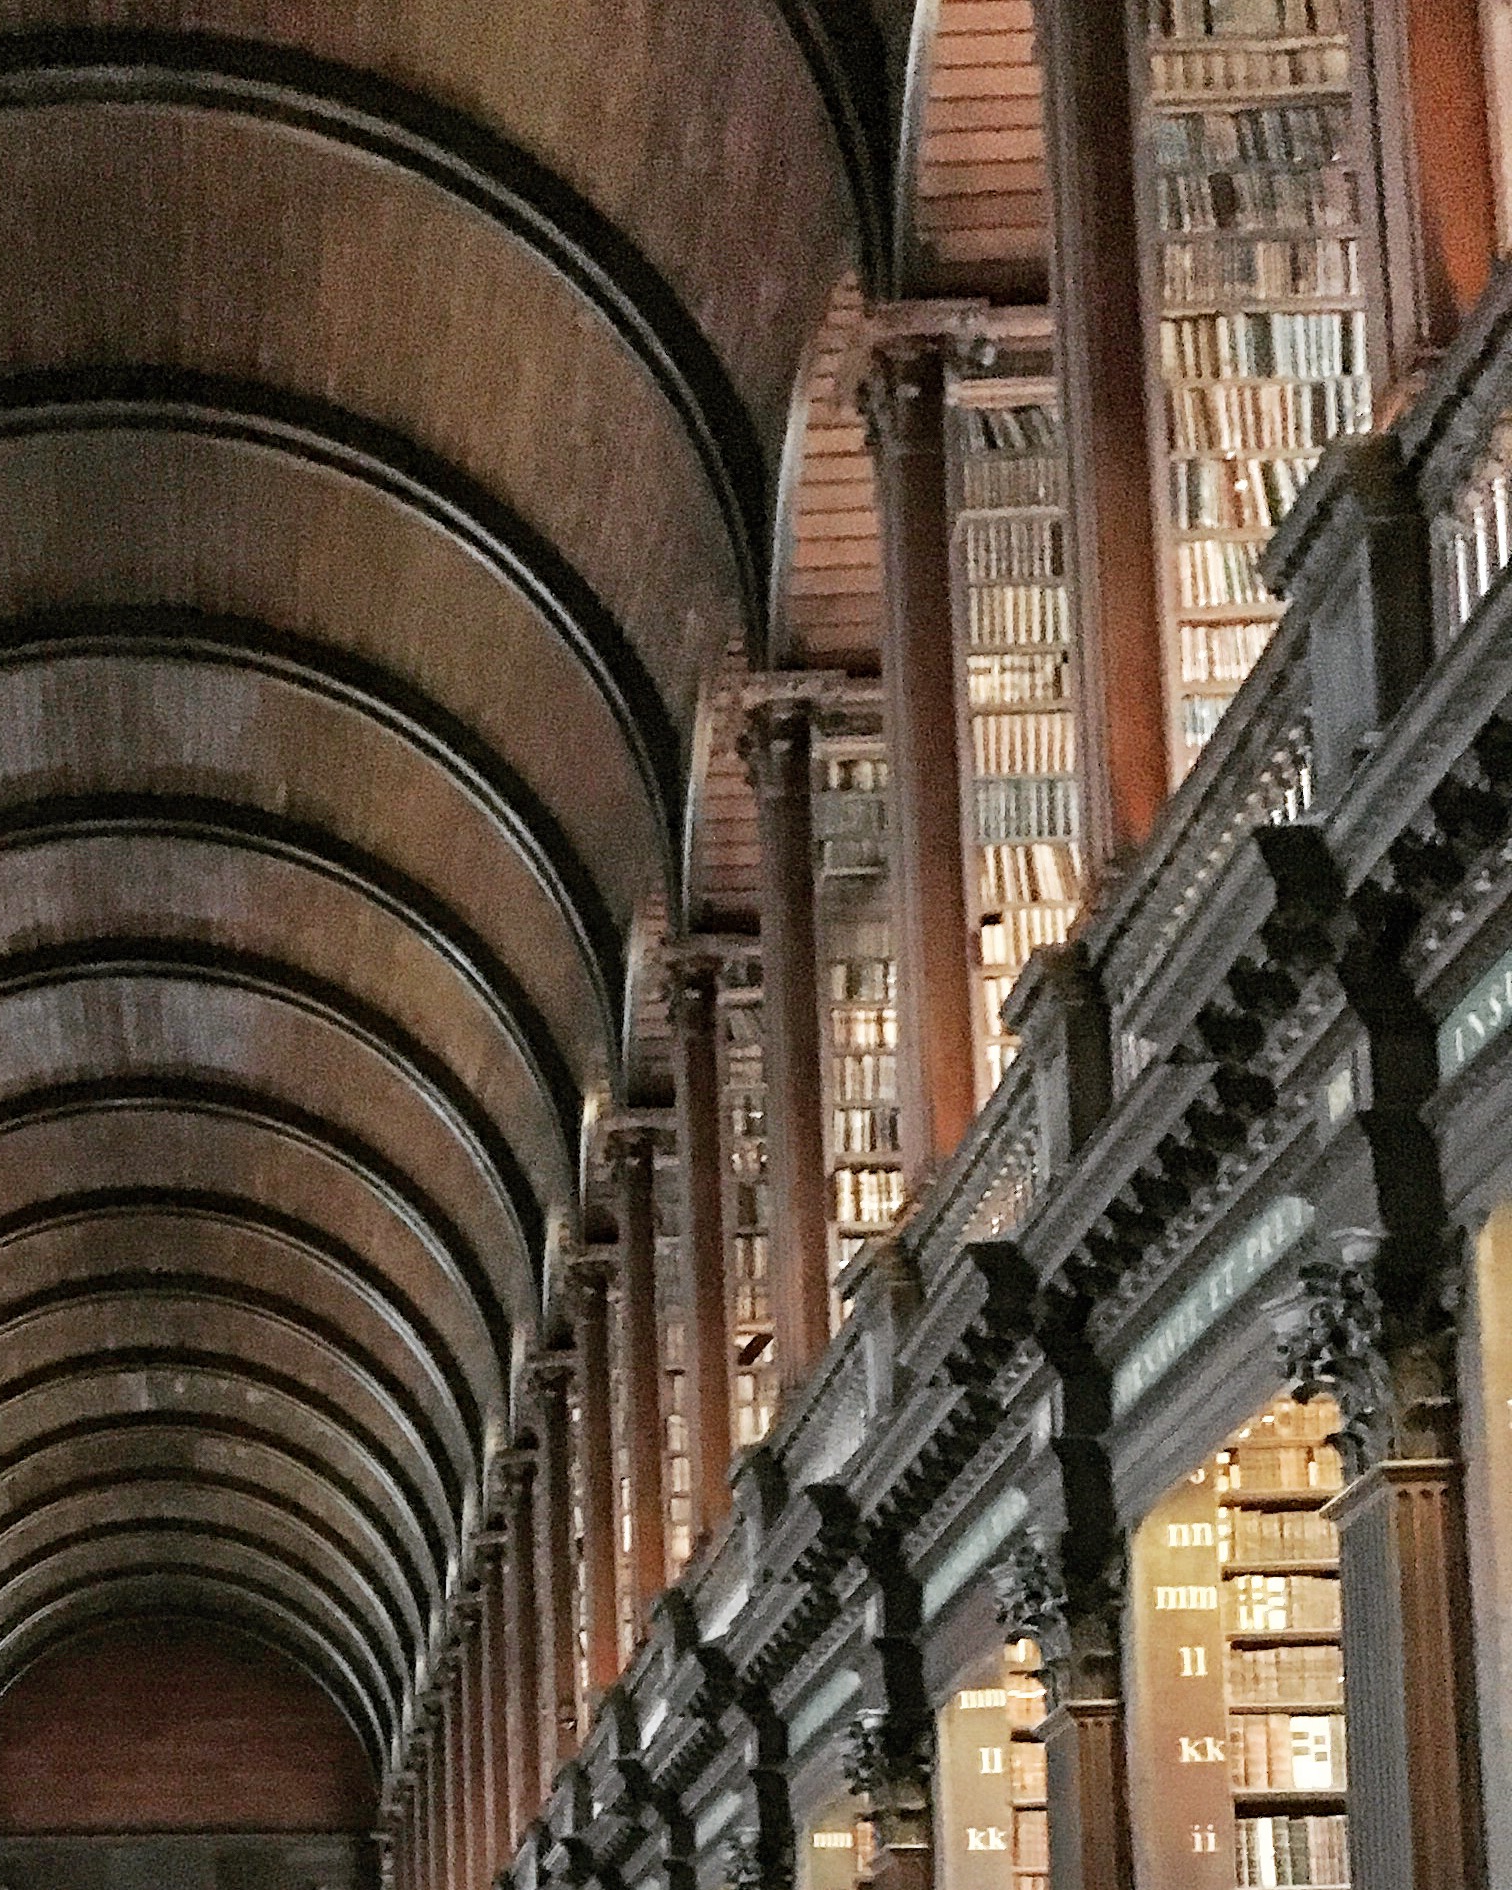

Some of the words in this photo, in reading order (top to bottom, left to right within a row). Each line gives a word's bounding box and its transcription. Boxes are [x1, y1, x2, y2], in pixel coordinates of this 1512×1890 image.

[1168, 1522, 1214, 1547] nn
[1155, 1585, 1218, 1610] mm
[1178, 1646, 1208, 1677] ll
[959, 1689, 1007, 1710] mm
[979, 1747, 1004, 1774] ll
[1178, 1736, 1225, 1764] kk
[966, 1827, 1007, 1850] kk
[1190, 1824, 1218, 1853] ii
